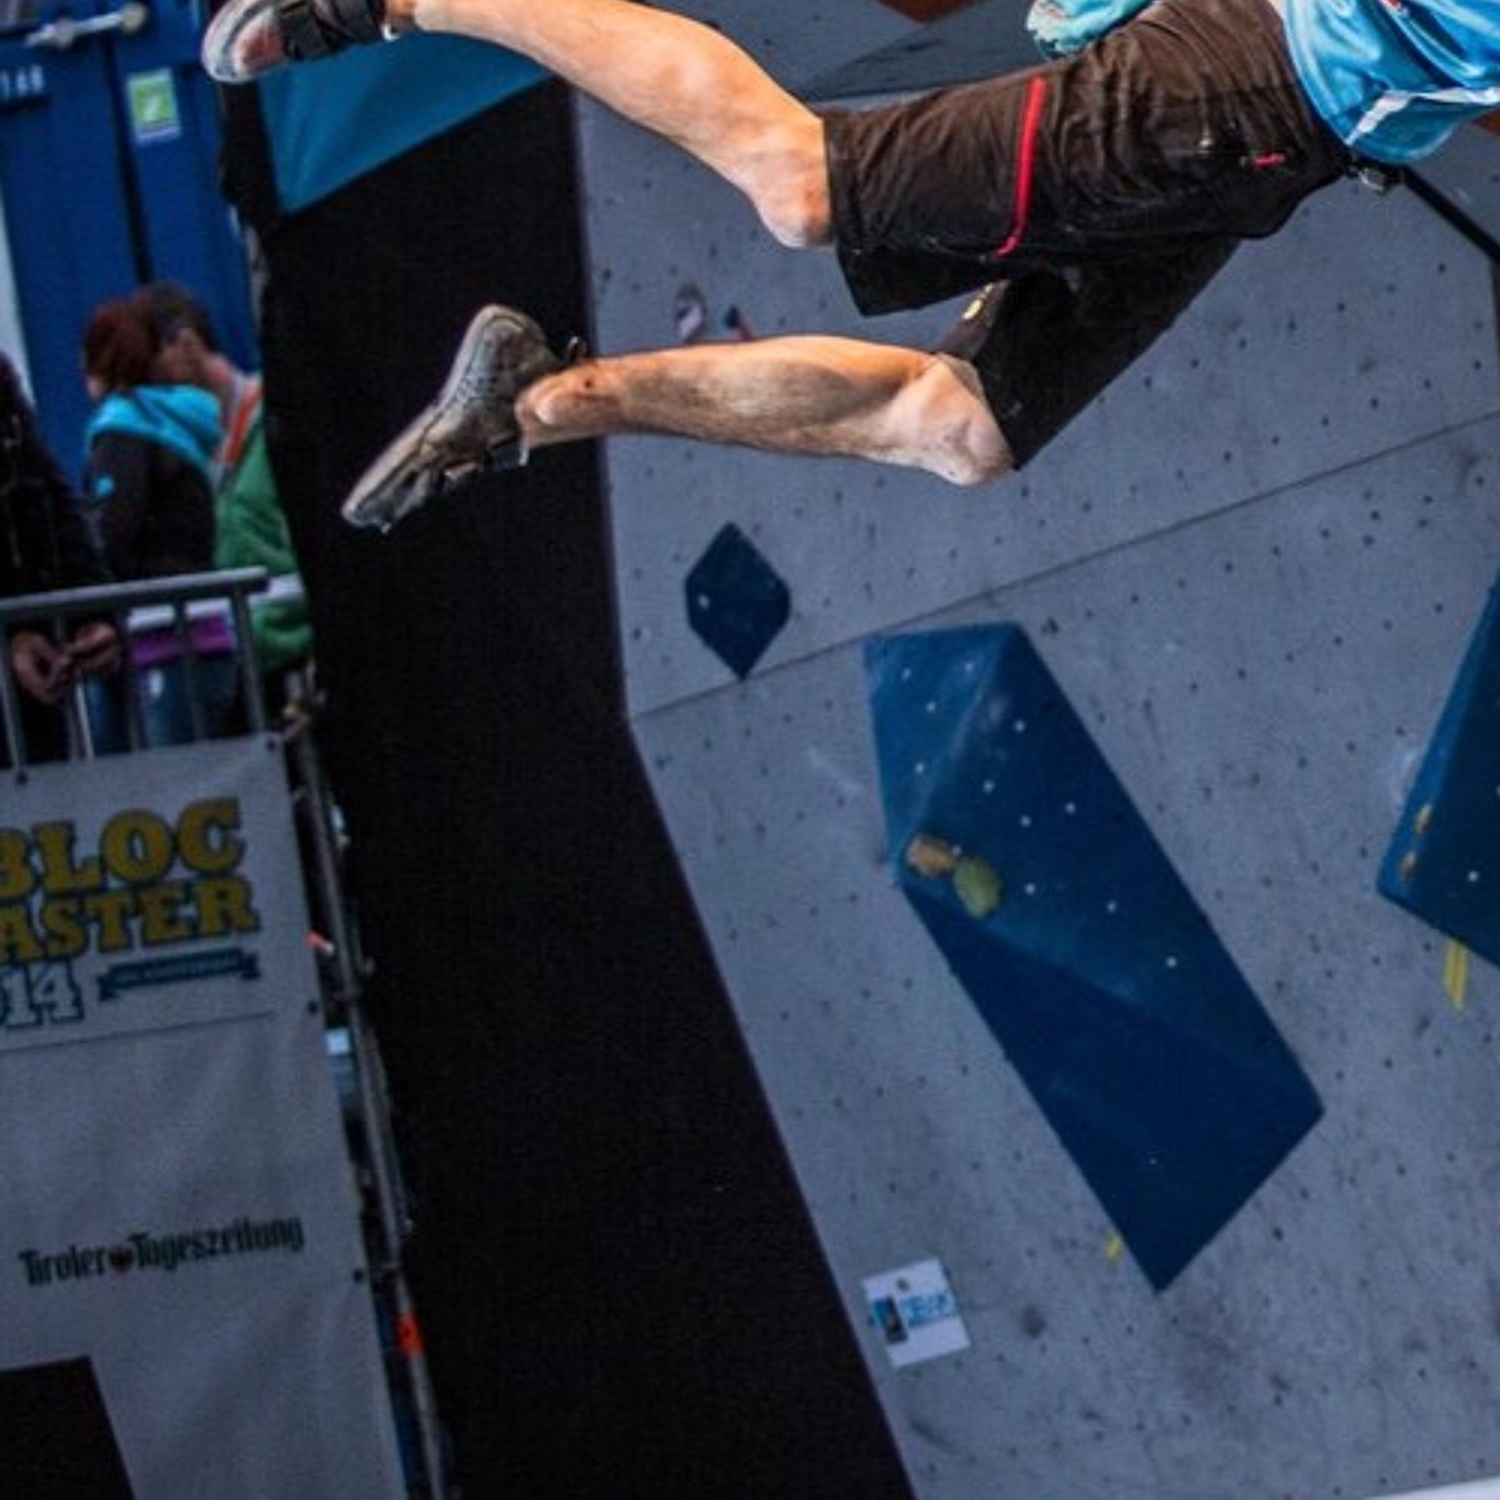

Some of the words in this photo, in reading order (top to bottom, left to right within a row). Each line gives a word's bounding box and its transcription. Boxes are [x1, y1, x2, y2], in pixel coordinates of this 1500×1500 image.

[0, 961, 85, 1031] 14
[18, 1244, 106, 1287] Tiroler
[127, 1216, 305, 1272] Tageszeitung
